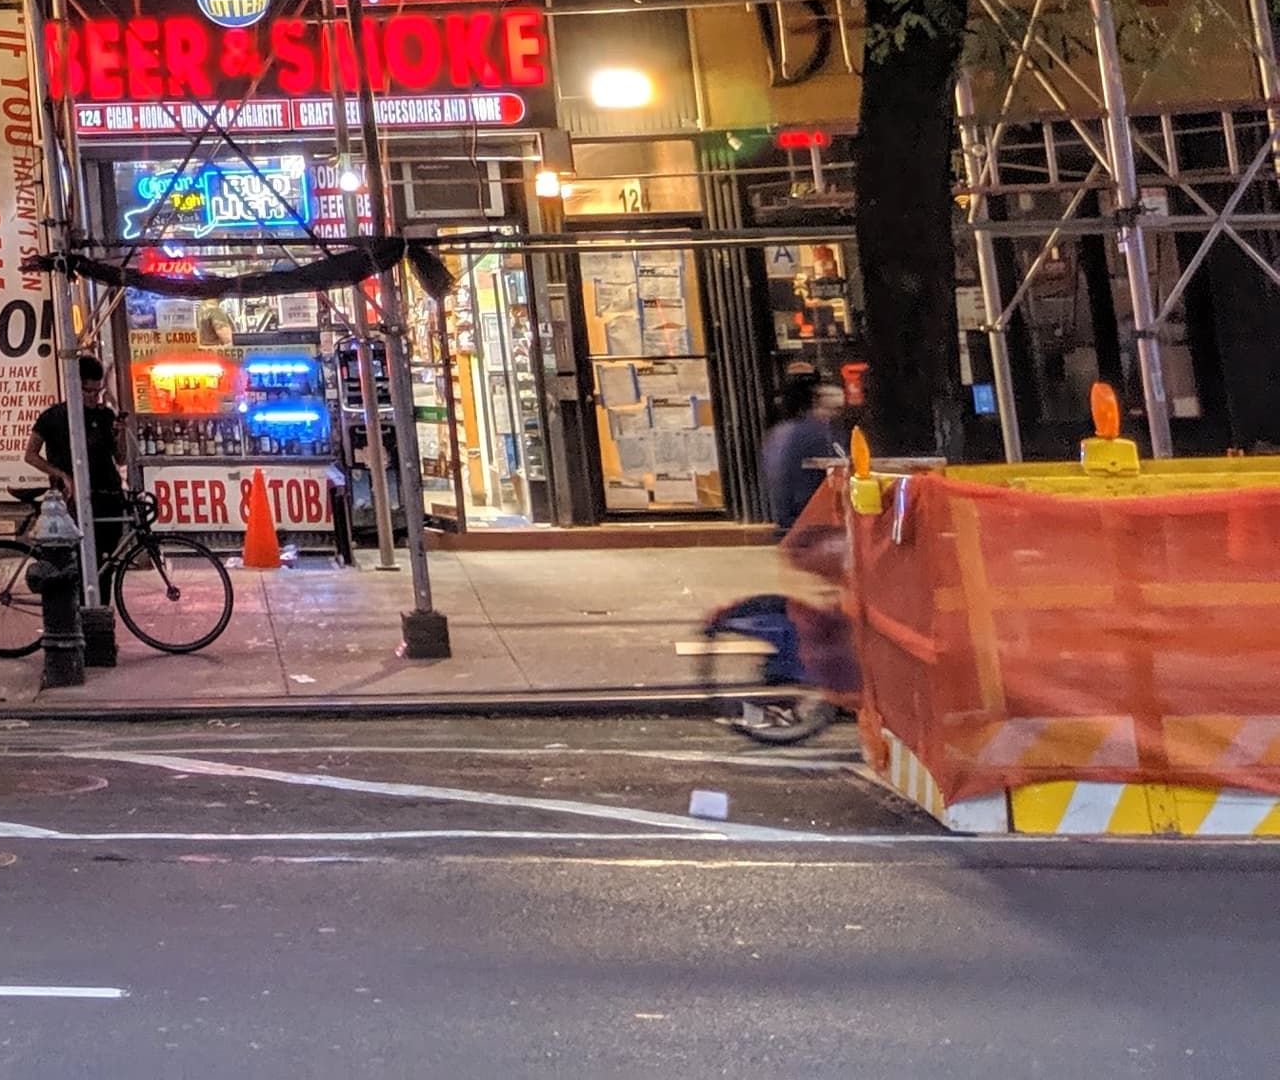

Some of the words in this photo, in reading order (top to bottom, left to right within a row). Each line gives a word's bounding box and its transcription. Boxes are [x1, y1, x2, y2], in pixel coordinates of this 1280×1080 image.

[46, 17, 213, 100] BEER
[220, 28, 263, 78] &
[271, 11, 546, 94] SMOKE
[0, 77, 35, 149] YOU
[78, 109, 102, 128] 124
[106, 106, 133, 130] CIGAR
[299, 101, 334, 127] CRAFT
[443, 97, 465, 122] AND
[618, 188, 652, 213] 124
[165, 331, 198, 345] CARDS
[9, 366, 39, 378] HAVE
[0, 380, 12, 395] IT,
[15, 380, 42, 393] TAKE
[27, 394, 56, 408] WHO
[16, 409, 41, 422] AND
[11, 424, 32, 437] THE
[154, 479, 230, 525] BEER
